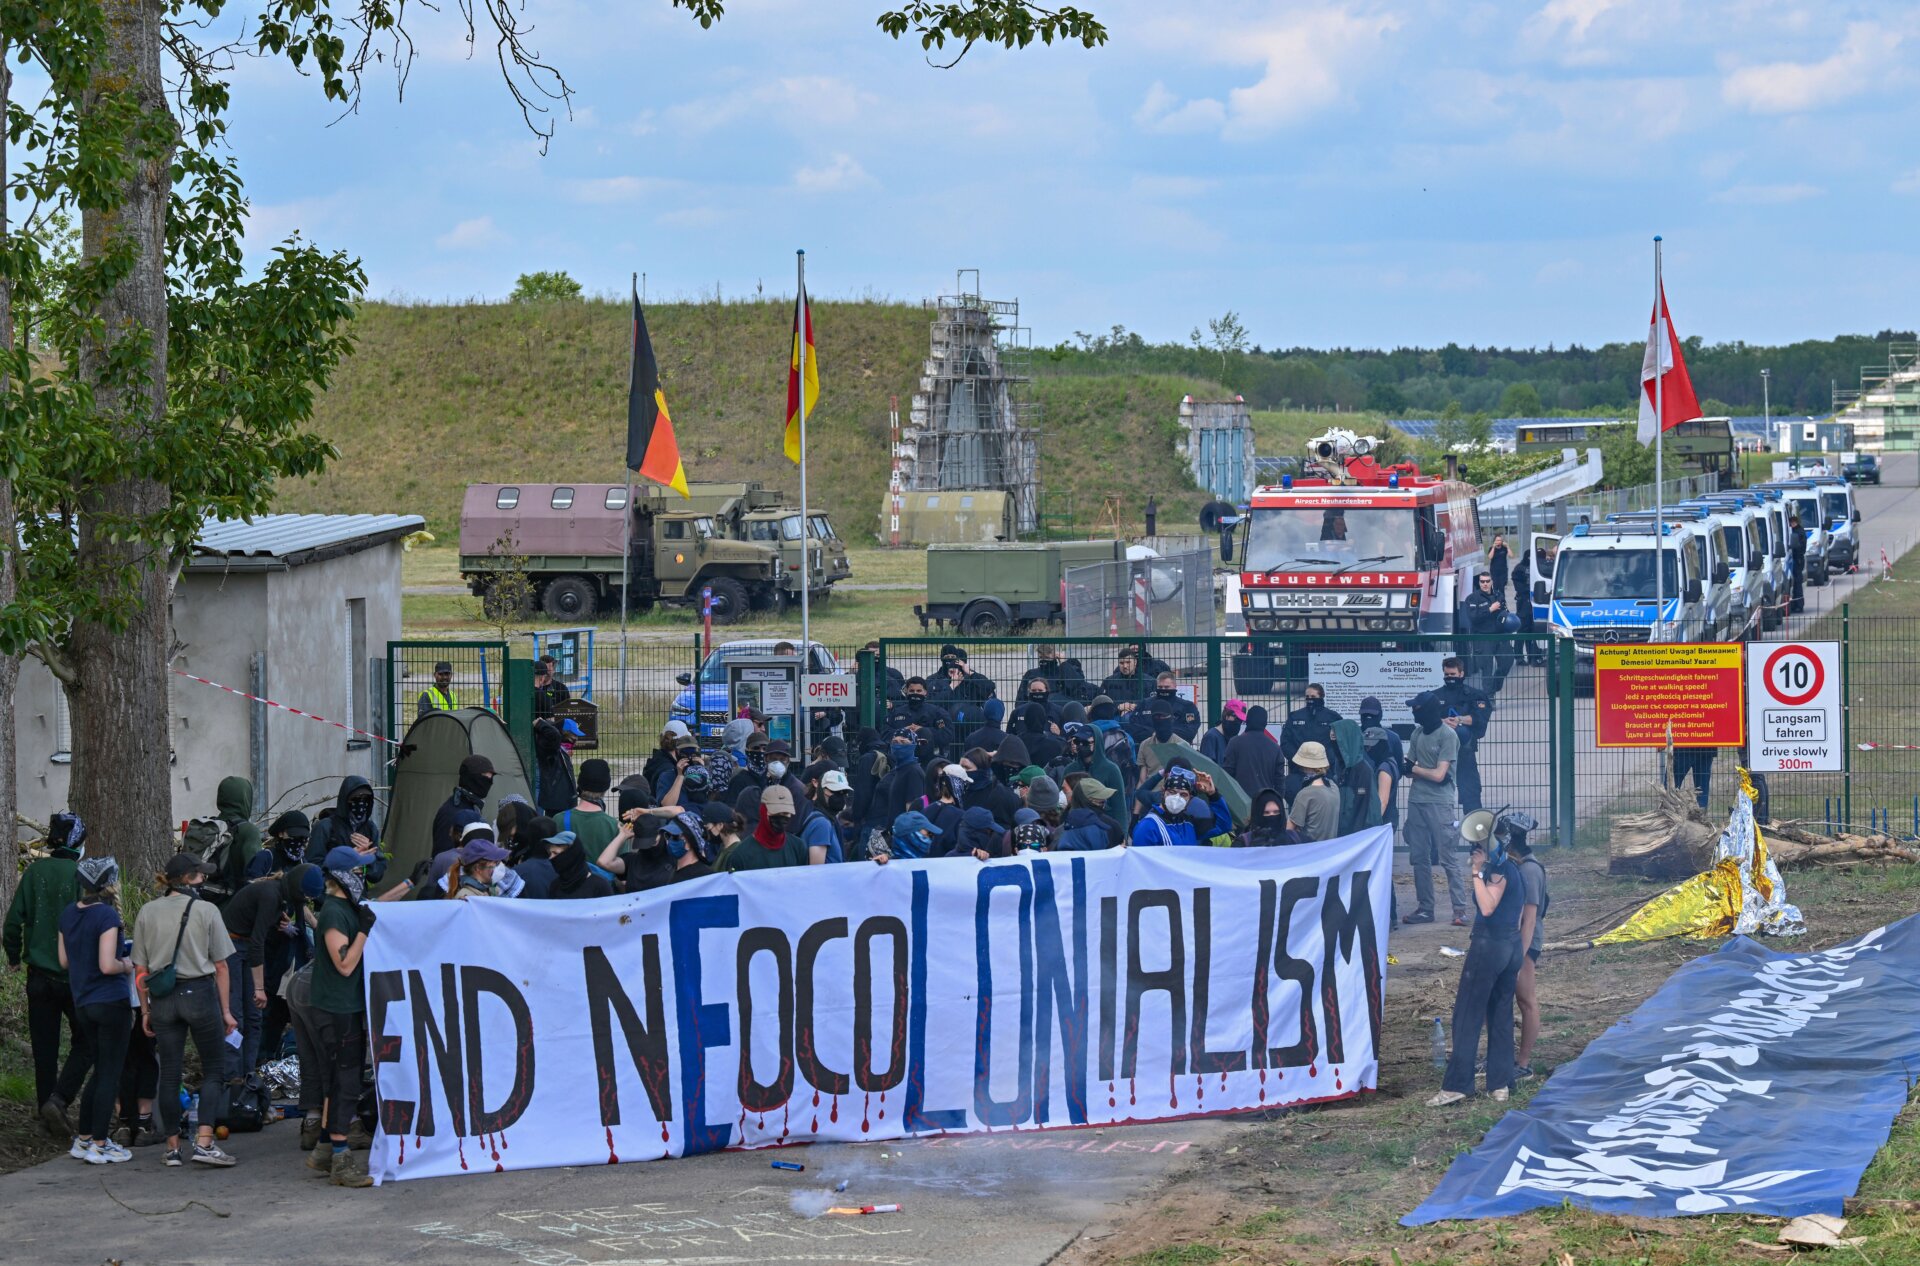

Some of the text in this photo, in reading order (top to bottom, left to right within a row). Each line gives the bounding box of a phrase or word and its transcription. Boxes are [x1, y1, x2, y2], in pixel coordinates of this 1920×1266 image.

[1253, 573, 1406, 585] Feuerwehr
[1581, 609, 1644, 618] POLIZEI
[1600, 648, 1631, 656] Achtung!
[1669, 648, 1697, 656] Uwaga!
[1345, 665, 1356, 673] 23
[1619, 674, 1693, 682] Schrittgeschwindigkeit
[1779, 662, 1808, 689] 10
[808, 682, 848, 696] OFFEN
[1658, 683, 1684, 692] walking
[1685, 683, 1708, 691] speed!
[1682, 693, 1714, 701] pieszego!
[1768, 713, 1821, 728] Langsam
[1776, 728, 1813, 738] fahren
[1762, 746, 1828, 759] drive slowly
[1778, 759, 1813, 770] 300m
[369, 963, 536, 1137] END
[583, 856, 1380, 1157] NEOCOLONIALISM
[495, 1202, 698, 1223] FREE
[588, 1234, 728, 1251] FOR
